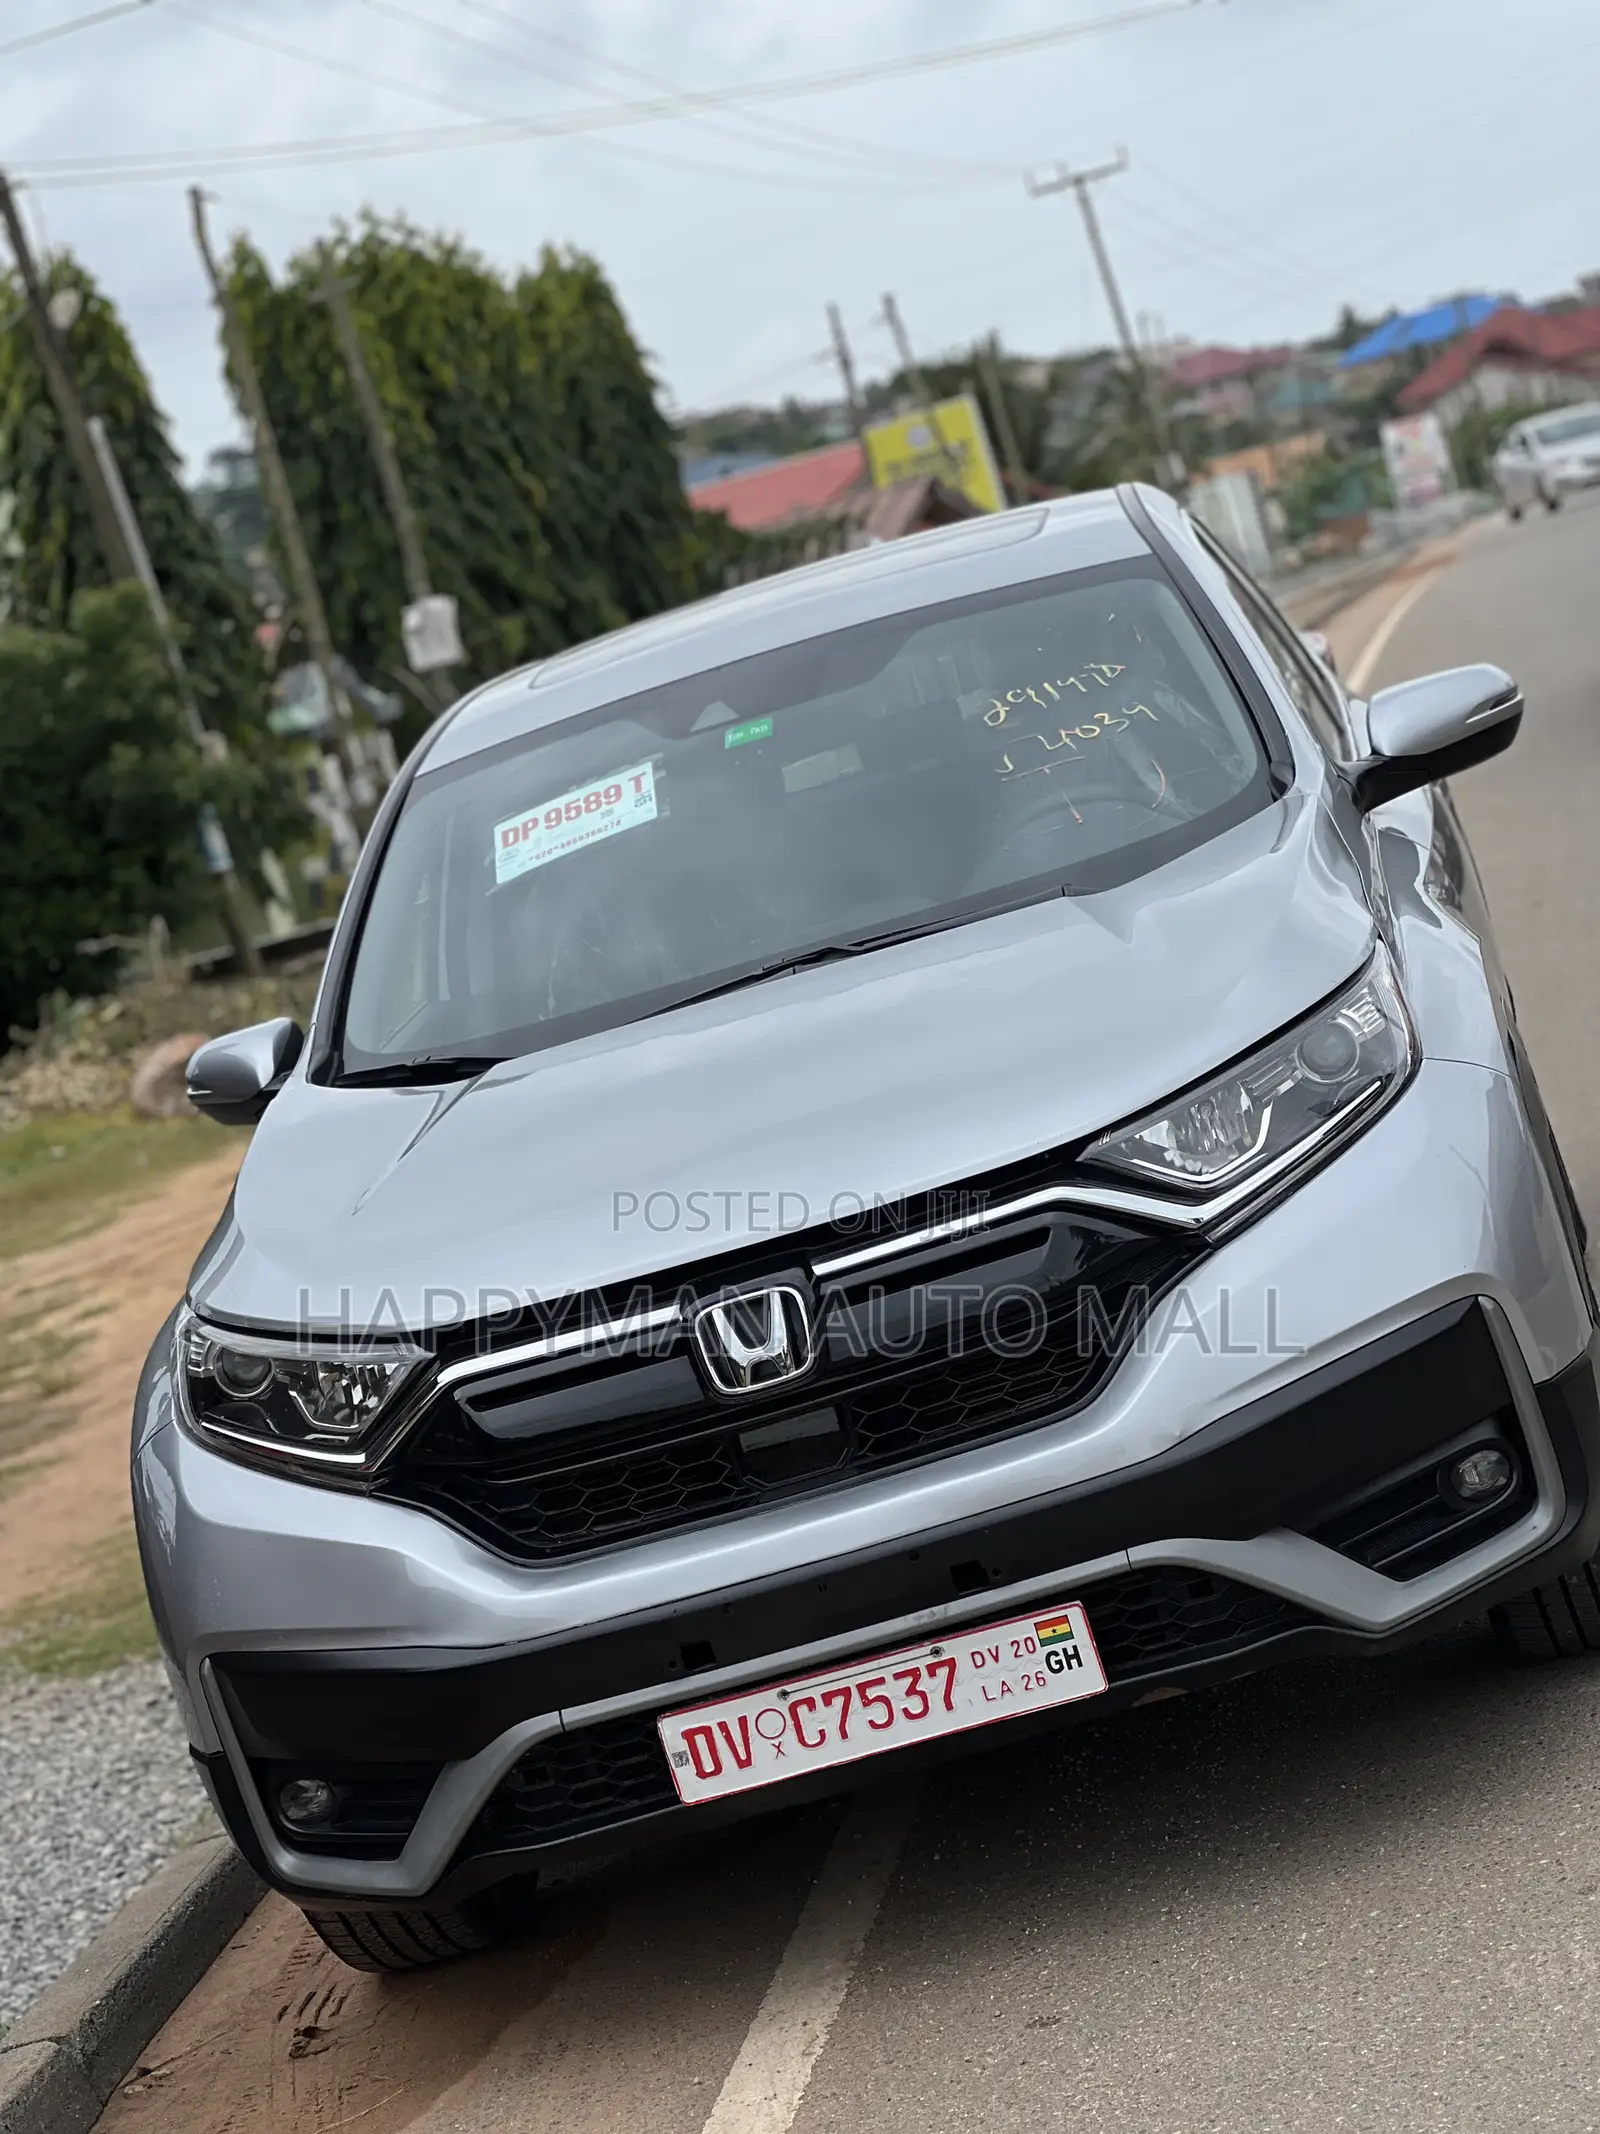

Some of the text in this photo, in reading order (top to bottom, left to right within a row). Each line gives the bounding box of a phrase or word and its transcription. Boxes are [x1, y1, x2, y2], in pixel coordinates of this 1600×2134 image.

[501, 771, 648, 849] DP 9589 T
[970, 1636, 1037, 1669] DV 20
[1044, 1644, 1084, 1674] GH
[981, 1670, 1047, 1703] LA 26
[681, 1656, 958, 1780] DV C7537
